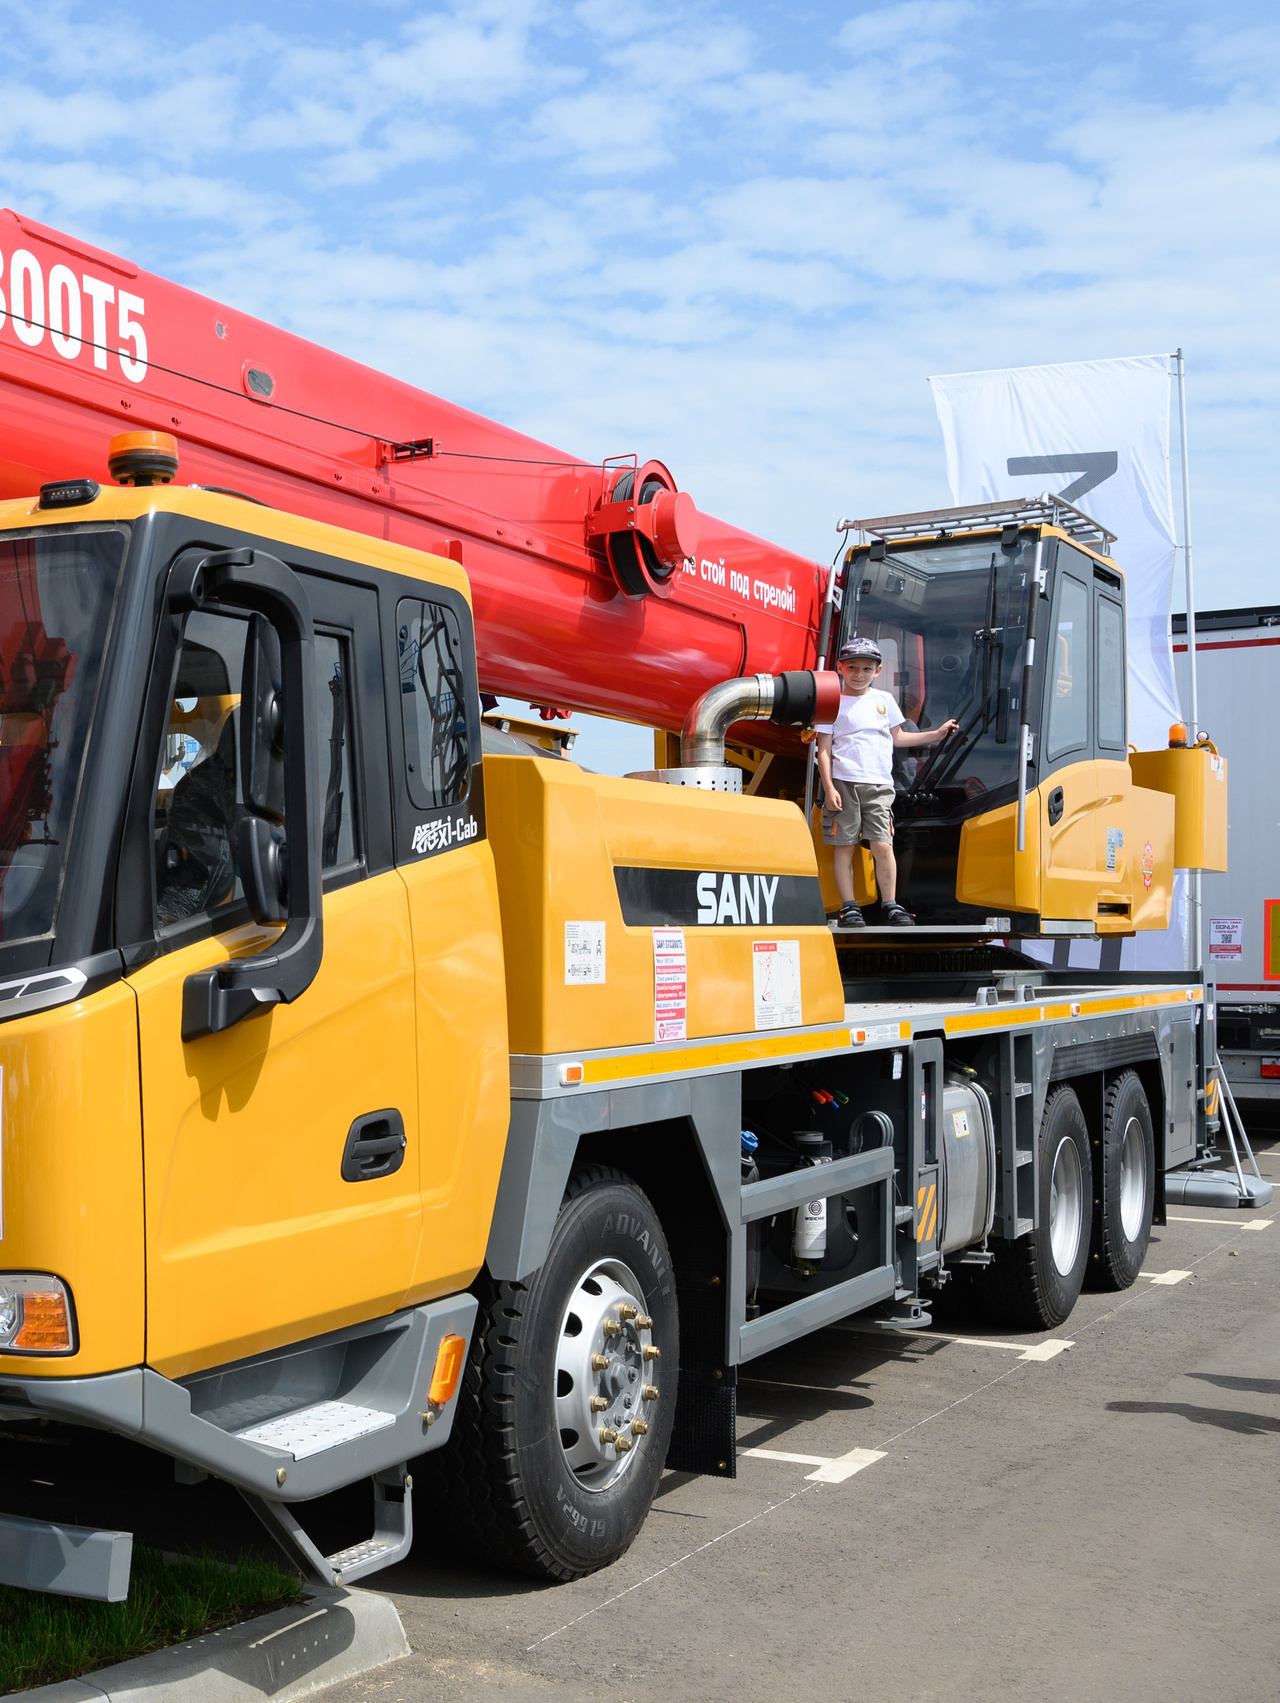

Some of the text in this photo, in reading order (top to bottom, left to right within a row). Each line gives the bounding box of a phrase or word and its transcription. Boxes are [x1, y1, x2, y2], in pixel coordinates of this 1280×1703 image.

[700, 558, 726, 586] стой
[730, 570, 750, 600] под
[753, 579, 796, 613] стрелой!
[696, 872, 780, 924] SANY
